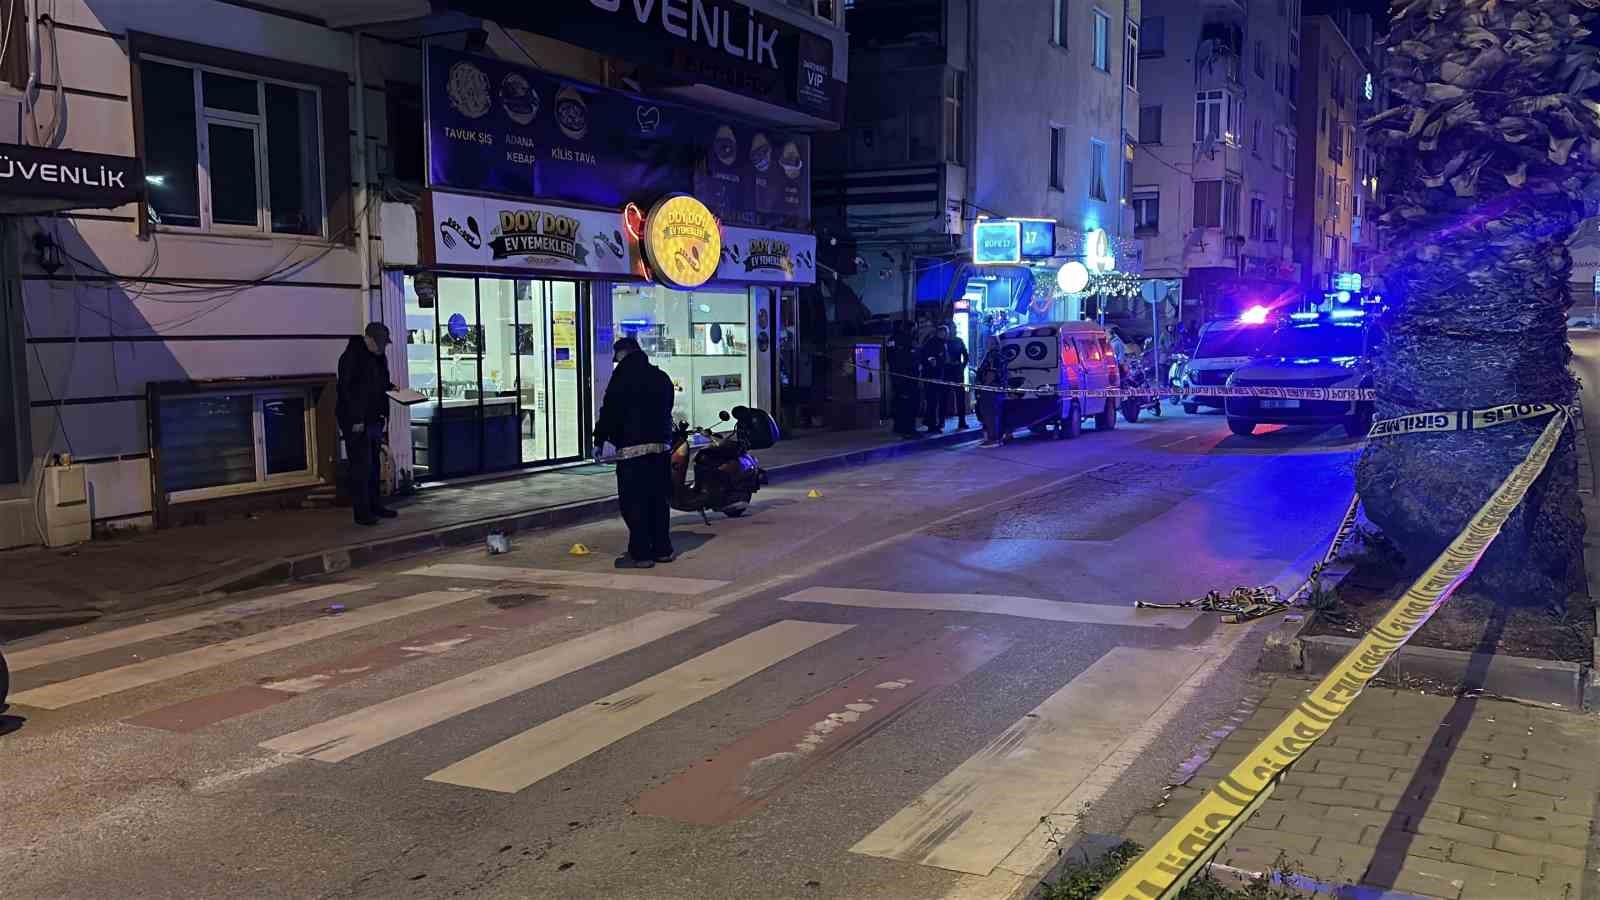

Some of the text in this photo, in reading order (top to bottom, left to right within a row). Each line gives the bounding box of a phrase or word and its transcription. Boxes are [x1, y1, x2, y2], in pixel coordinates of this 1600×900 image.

[444, 127, 478, 143] TAVUK
[499, 210, 540, 235] DOY
[543, 212, 580, 242] DOY
[504, 236, 519, 251] EV
[1024, 231, 1038, 244] 17
